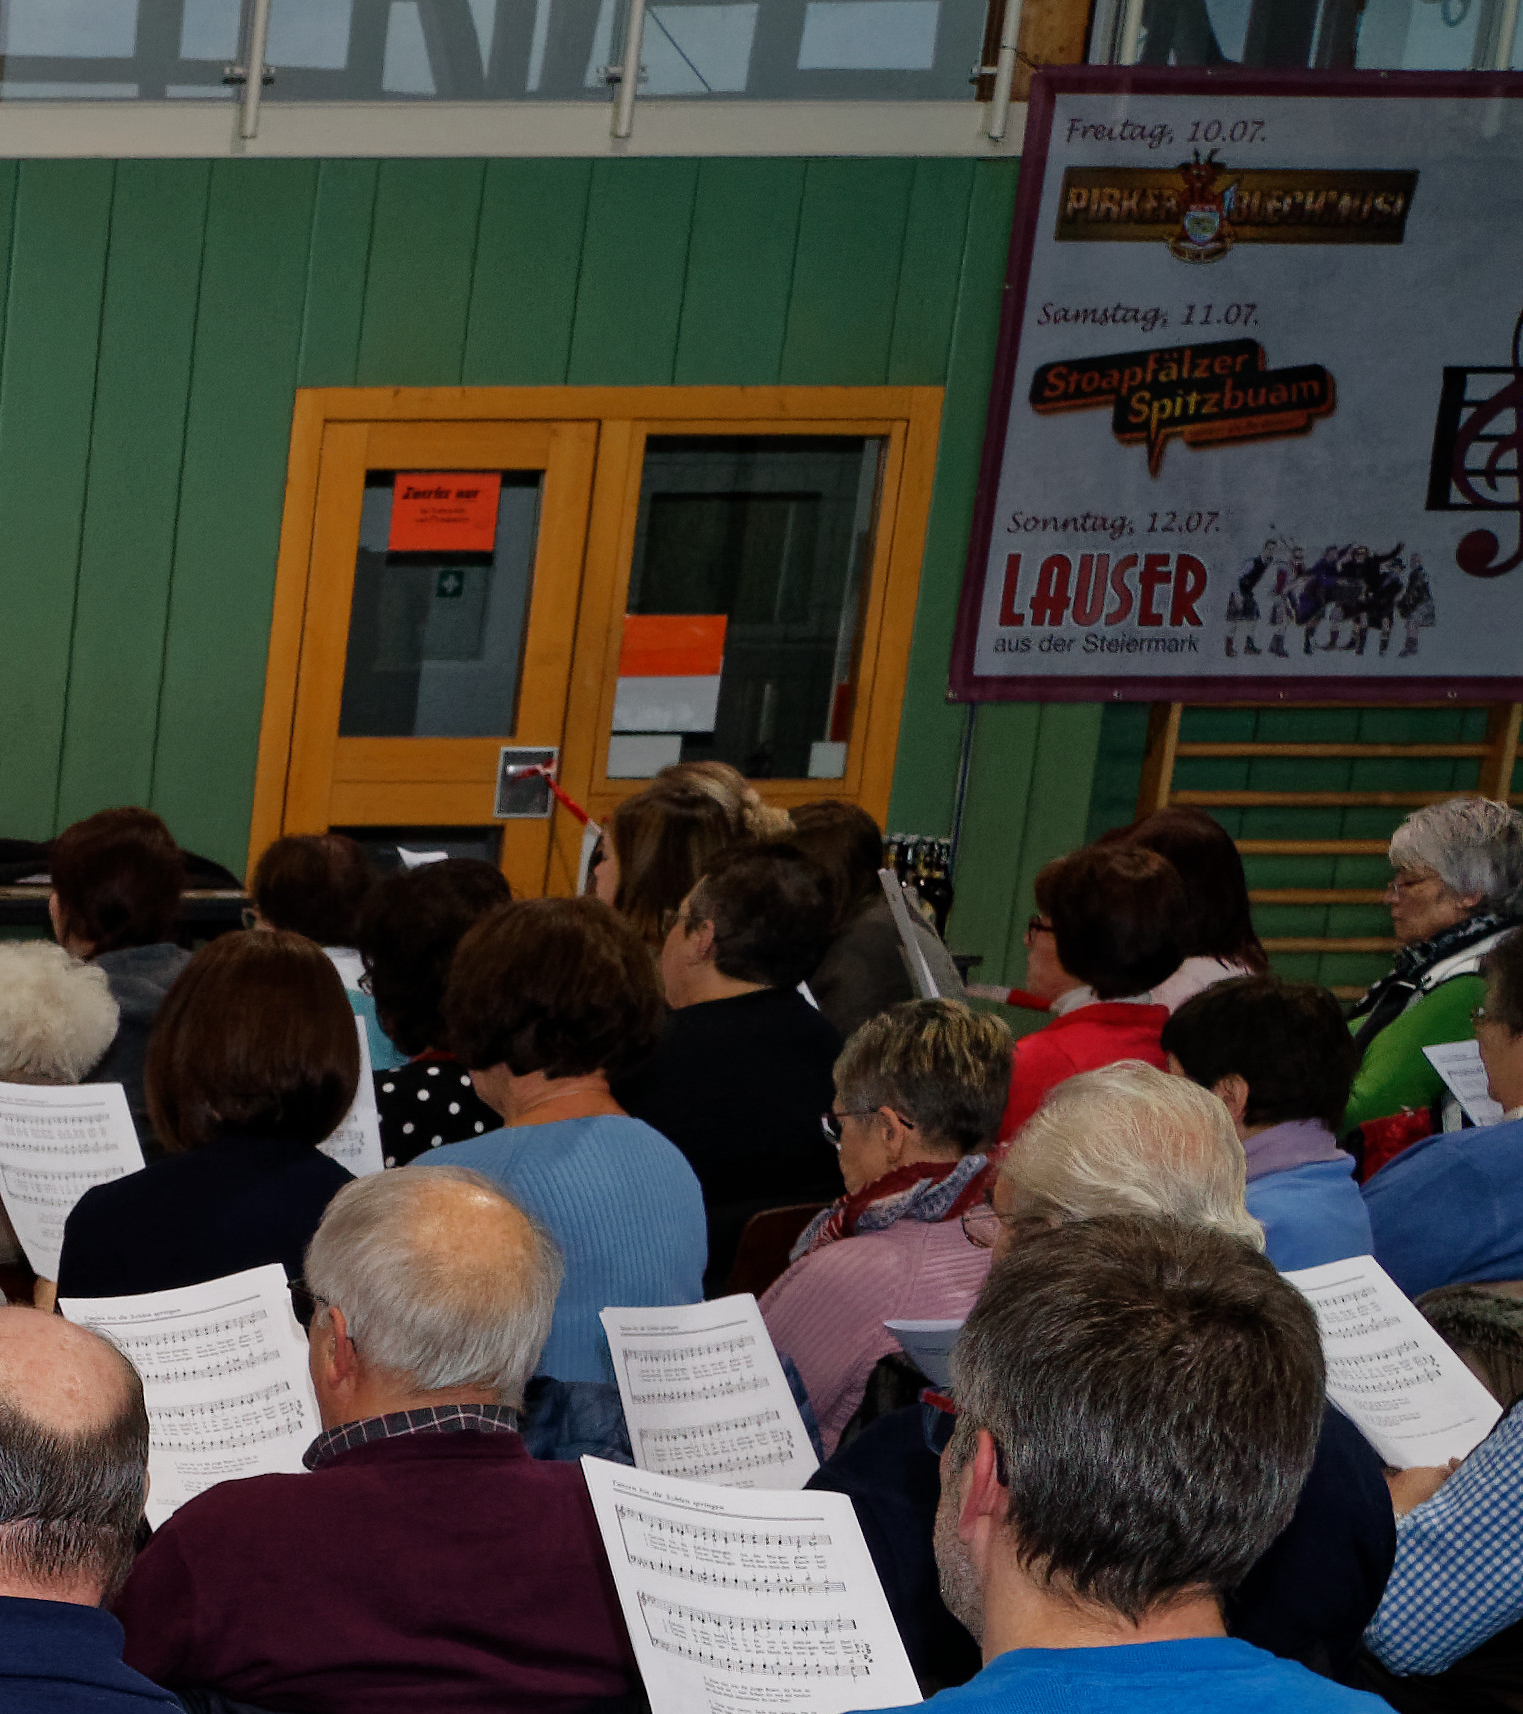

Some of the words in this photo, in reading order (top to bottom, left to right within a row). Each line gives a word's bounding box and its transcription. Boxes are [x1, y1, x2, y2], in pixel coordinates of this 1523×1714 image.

[1067, 118, 1173, 149] Freitag,
[1187, 120, 1267, 143] 10.07.
[1066, 187, 1180, 223] PIRKER
[1037, 302, 1168, 332] Samstag,
[1181, 303, 1259, 326] 11.07.
[1043, 349, 1251, 397] Stoapfälzer
[1128, 377, 1321, 440] Spitzbuam
[1007, 510, 1136, 541] Sonntag,
[1147, 511, 1220, 533] 12.07.
[999, 553, 1207, 626] LAUSER
[995, 636, 1031, 653] aus
[1038, 634, 1075, 653] der
[1083, 633, 1199, 654] Steiermark
